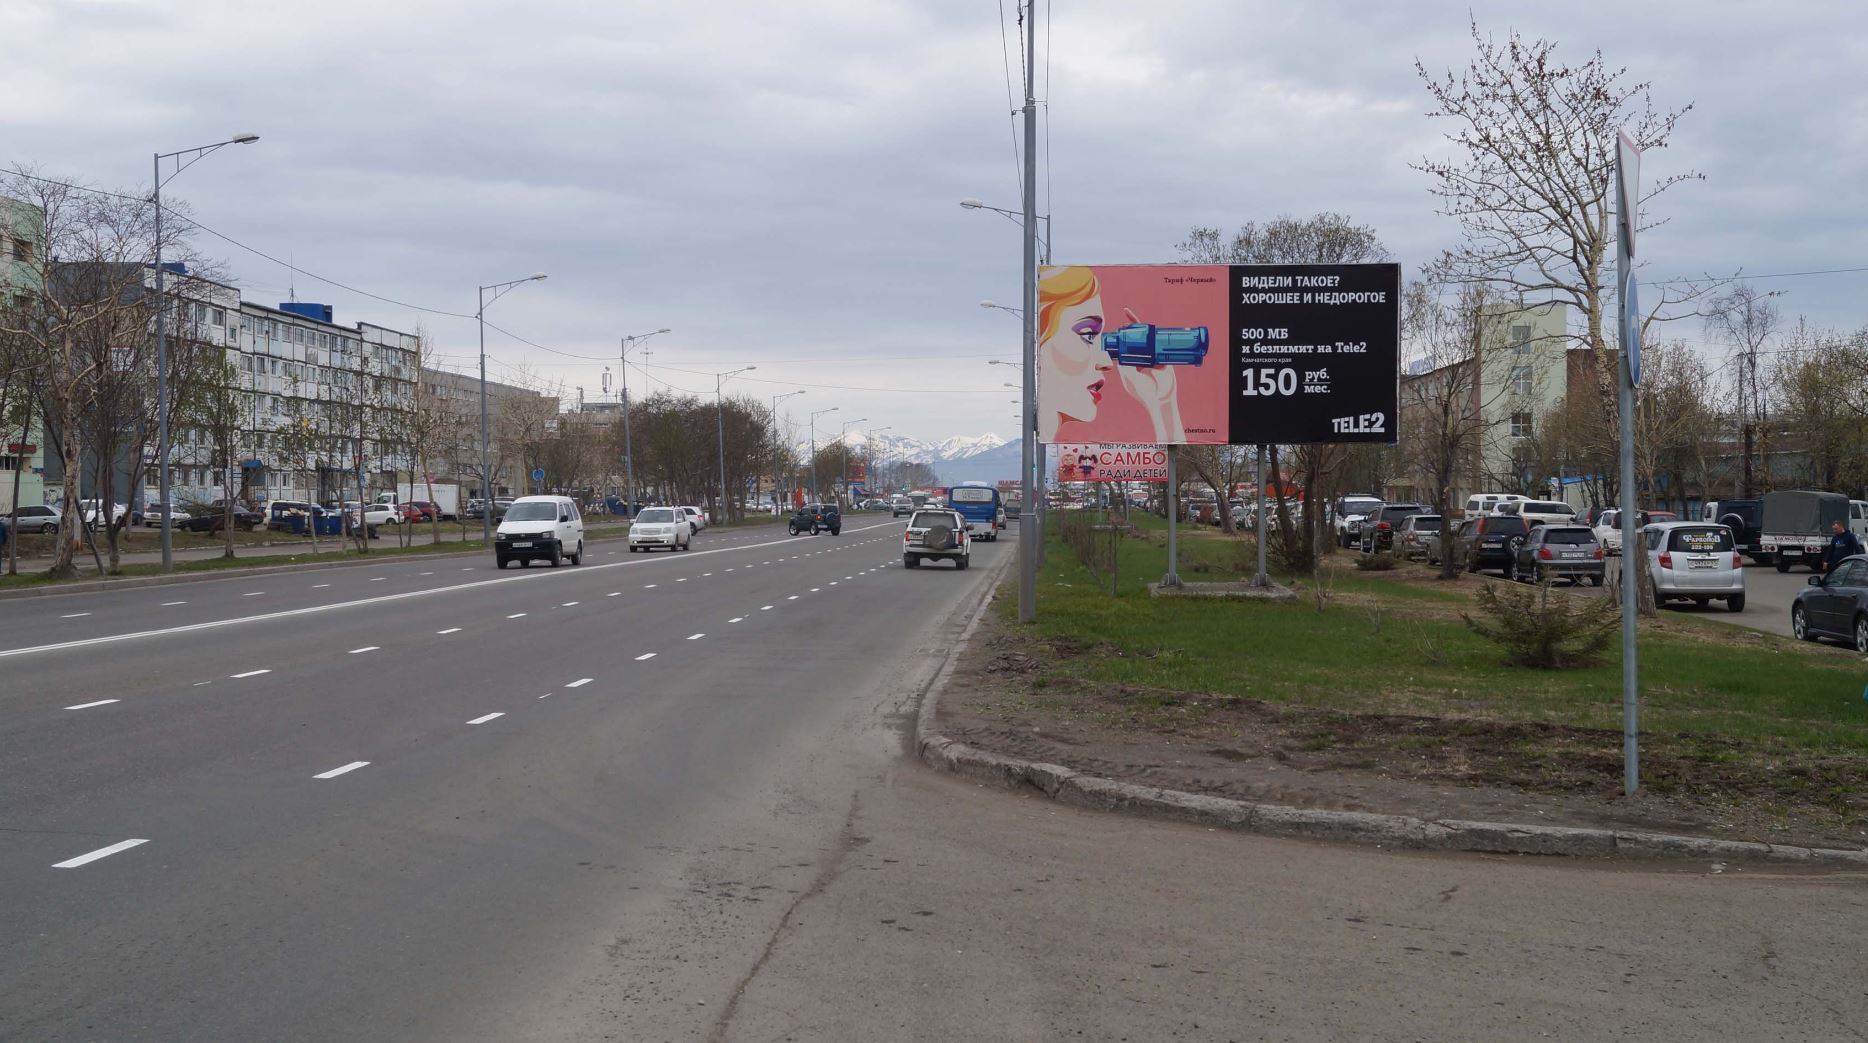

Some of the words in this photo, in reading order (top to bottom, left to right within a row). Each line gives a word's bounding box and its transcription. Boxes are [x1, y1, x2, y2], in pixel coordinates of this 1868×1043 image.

[1242, 276, 1292, 289] ВИДЕЛИ
[1296, 275, 1340, 287] ТАКОЕ?
[1242, 293, 1301, 304] ХОРОШЕЕ
[1303, 293, 1312, 304] И
[1315, 292, 1386, 305] НЕДОРОГОЕ
[1241, 328, 1264, 340] 500
[1267, 328, 1289, 339] МБ
[1241, 345, 1251, 353] и
[1253, 342, 1314, 353] безлимит
[1317, 344, 1333, 353] на
[1335, 341, 1367, 353] Tele2
[1242, 367, 1298, 396] 150
[1304, 368, 1330, 382] руб.
[1303, 385, 1331, 393] мес.
[1331, 412, 1385, 433] TELE2
[1100, 452, 1166, 466] САМБО
[1100, 469, 1131, 479] РАДИ
[1133, 467, 1167, 478] ДЕТЕЙ
